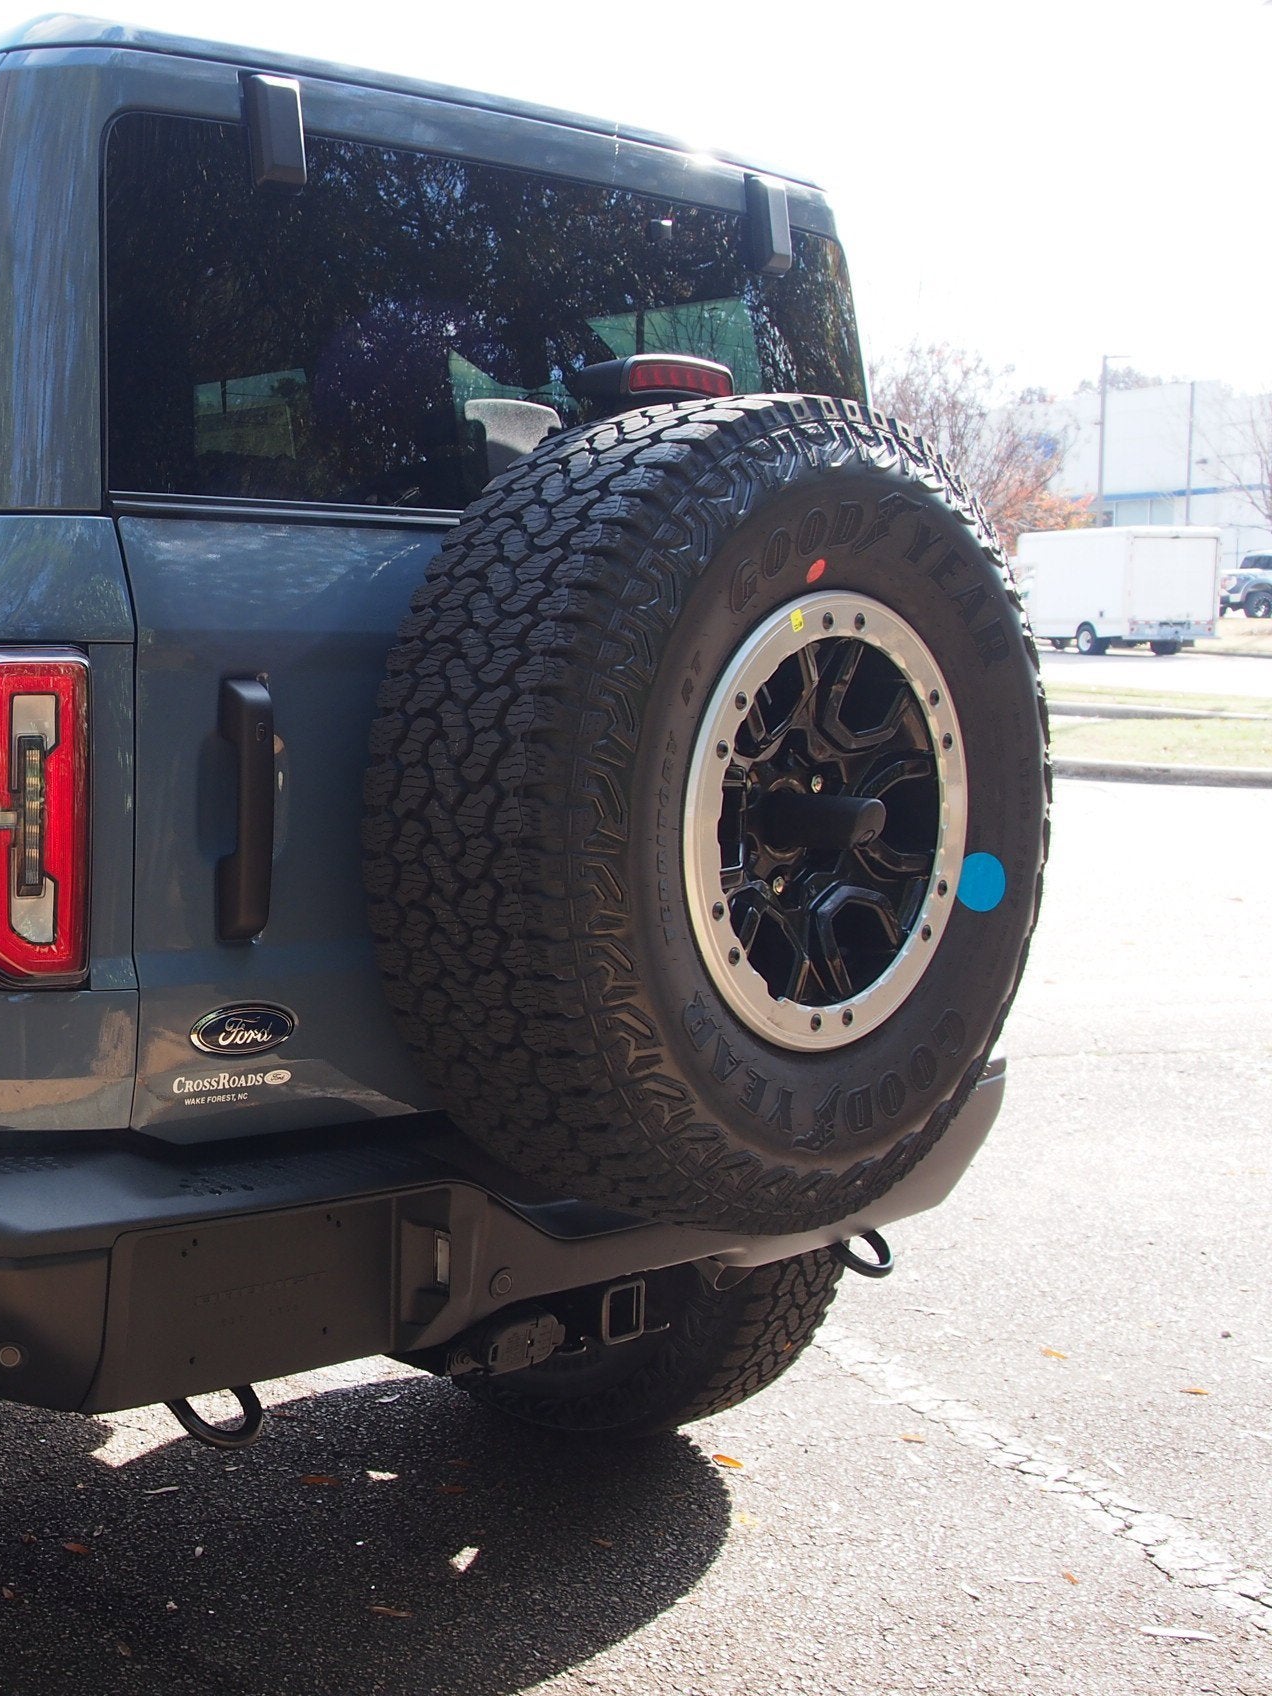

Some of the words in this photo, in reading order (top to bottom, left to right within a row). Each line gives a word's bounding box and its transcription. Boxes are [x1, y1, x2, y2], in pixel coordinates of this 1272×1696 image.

[218, 1016, 273, 1046] Ford
[184, 1096, 206, 1106] WAKE
[206, 1093, 236, 1104] FOREST,
[237, 1092, 249, 1101] NC
